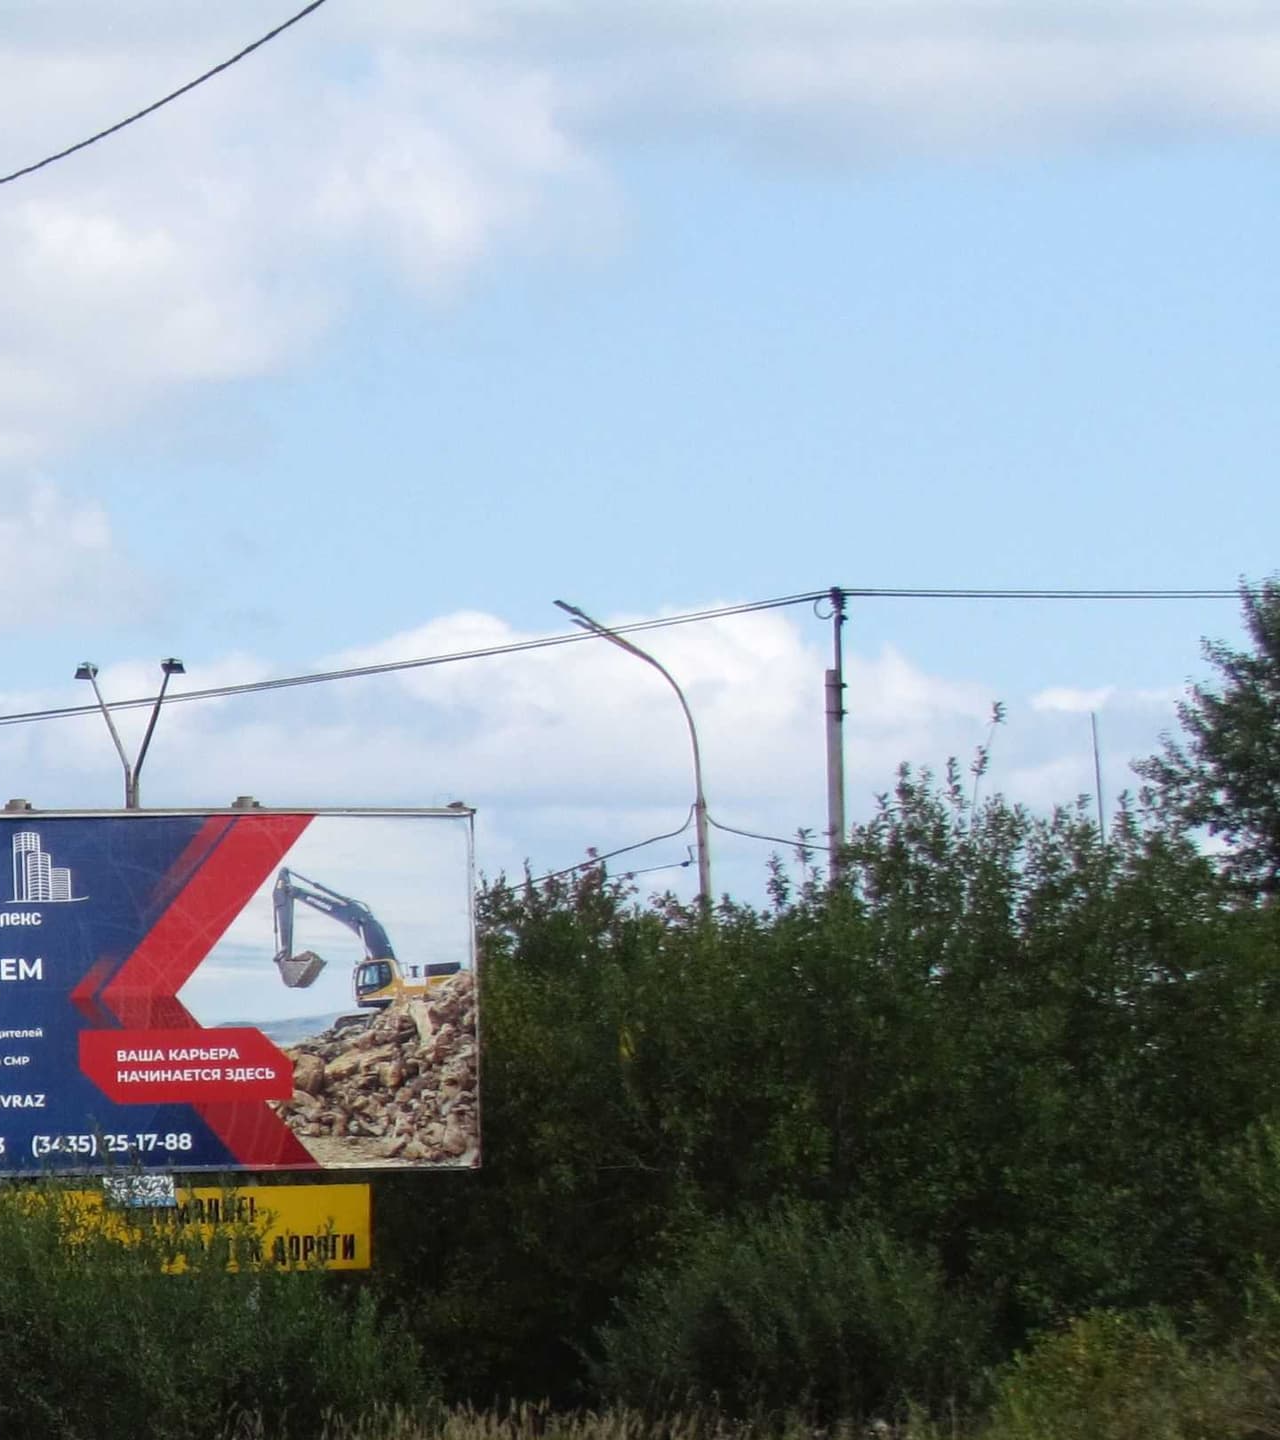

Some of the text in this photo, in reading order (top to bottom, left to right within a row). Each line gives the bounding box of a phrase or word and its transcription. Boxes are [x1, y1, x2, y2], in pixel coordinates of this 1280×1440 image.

[3, 1056, 30, 1066] СМР
[116, 1047, 240, 1062] ВАША КАРЬЕРА
[117, 1067, 276, 1083] НАЧИНАЕТСЯ ЗДЕСЬ
